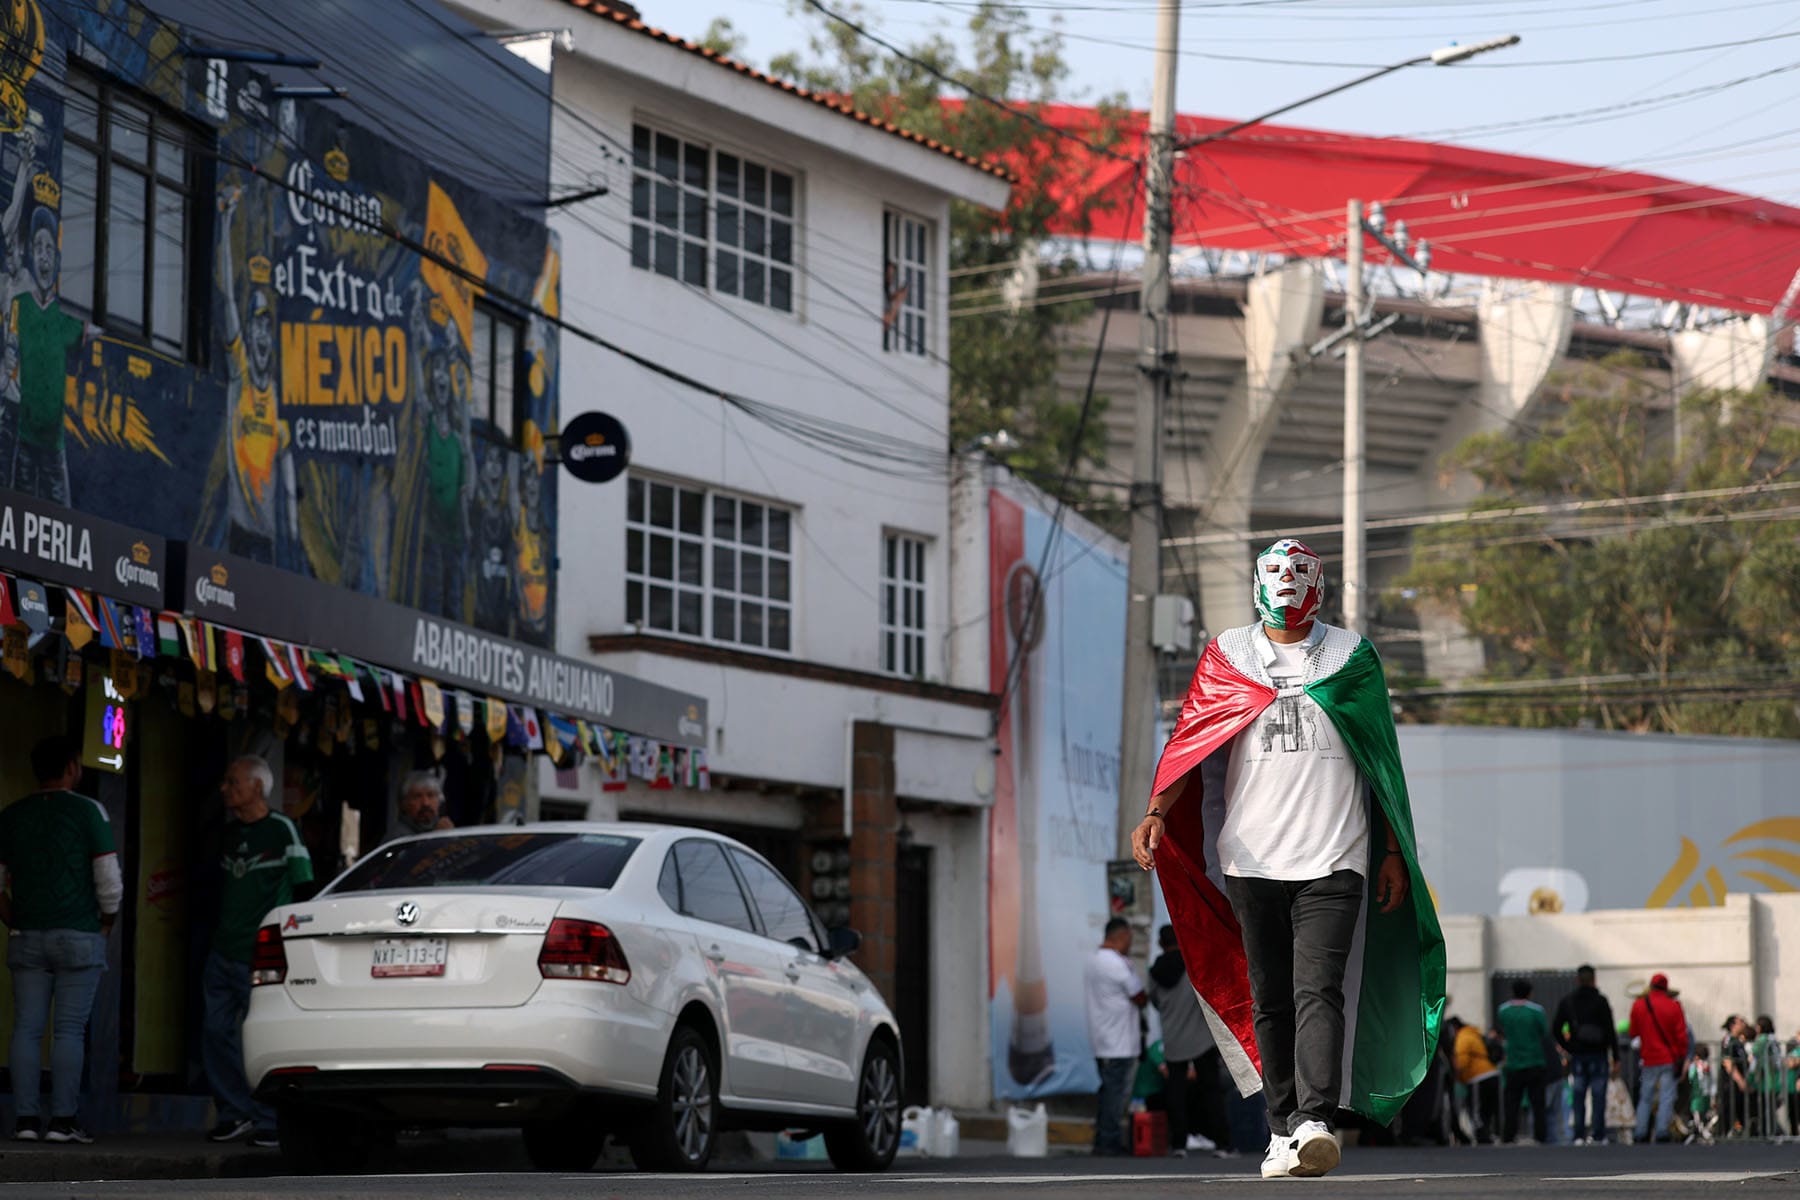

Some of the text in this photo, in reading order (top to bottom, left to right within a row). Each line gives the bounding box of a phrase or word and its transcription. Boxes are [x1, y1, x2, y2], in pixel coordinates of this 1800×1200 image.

[275, 256, 295, 298] el
[297, 244, 385, 321] Extra
[280, 307, 407, 406] MÉXICO
[295, 404, 397, 456] es mundial
[23, 510, 94, 572] PERLA
[115, 555, 161, 592] Corona
[194, 575, 237, 611] Corona
[412, 617, 525, 694] ABARROTES
[527, 654, 615, 718] ANGUIANO
